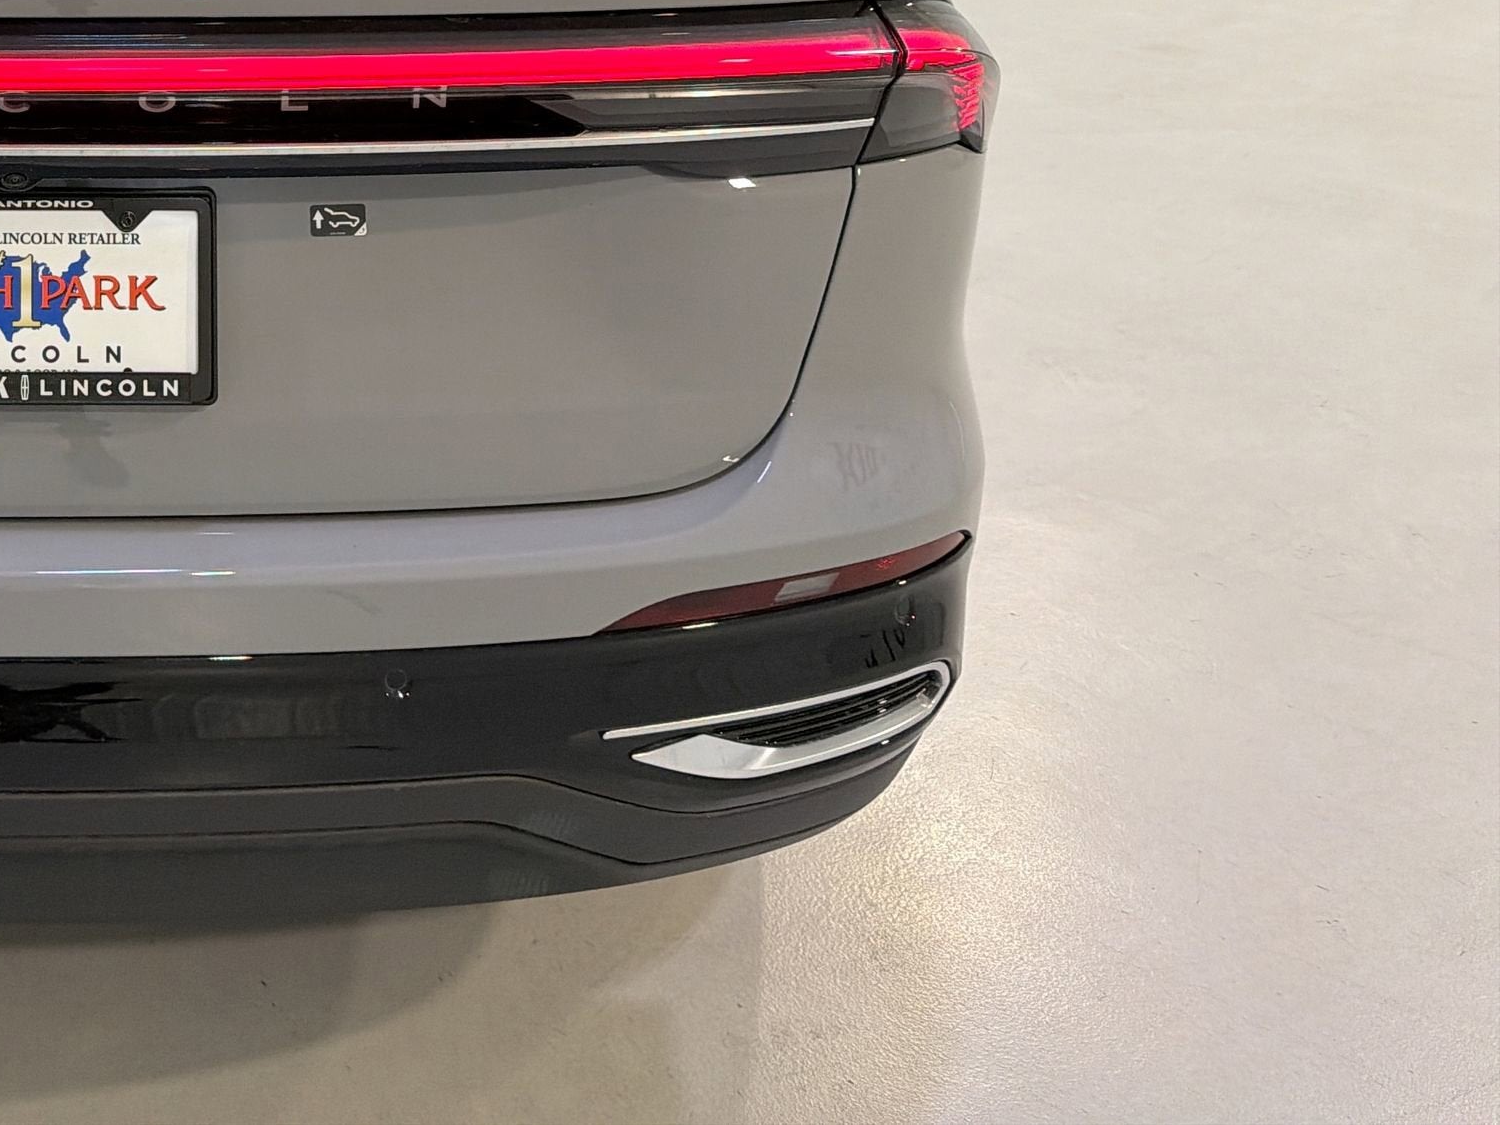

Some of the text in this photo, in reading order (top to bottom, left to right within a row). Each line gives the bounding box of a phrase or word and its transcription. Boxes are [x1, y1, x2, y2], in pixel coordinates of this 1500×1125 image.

[67, 232, 141, 245] RETAILER
[40, 275, 166, 311] PARK
[39, 378, 179, 396] LINCOLN
